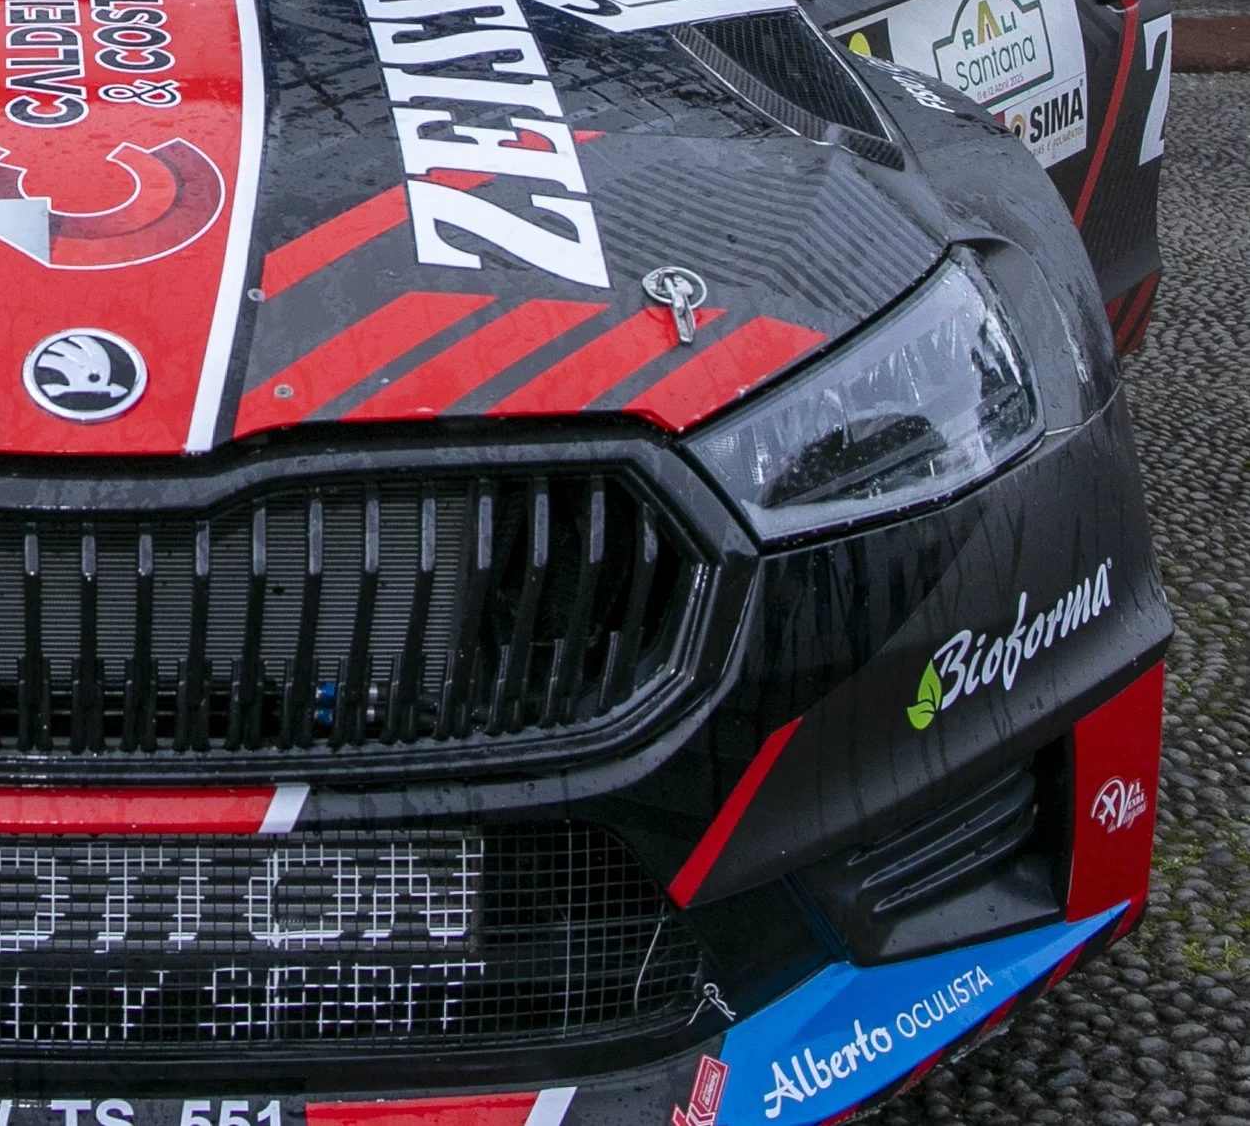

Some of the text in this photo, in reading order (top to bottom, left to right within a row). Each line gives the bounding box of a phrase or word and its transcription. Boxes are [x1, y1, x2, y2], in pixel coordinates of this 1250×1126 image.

[961, 0, 1017, 50] RALI
[955, 35, 1036, 92] Santana
[995, 79, 1010, 94] Abril
[1010, 73, 1024, 86] 2025
[98, 79, 182, 107] &
[1029, 87, 1084, 144] SIMA
[933, 563, 1111, 711] Bioforma
[764, 1018, 893, 1119] Alberto
[896, 964, 994, 1040] OCULISTA
